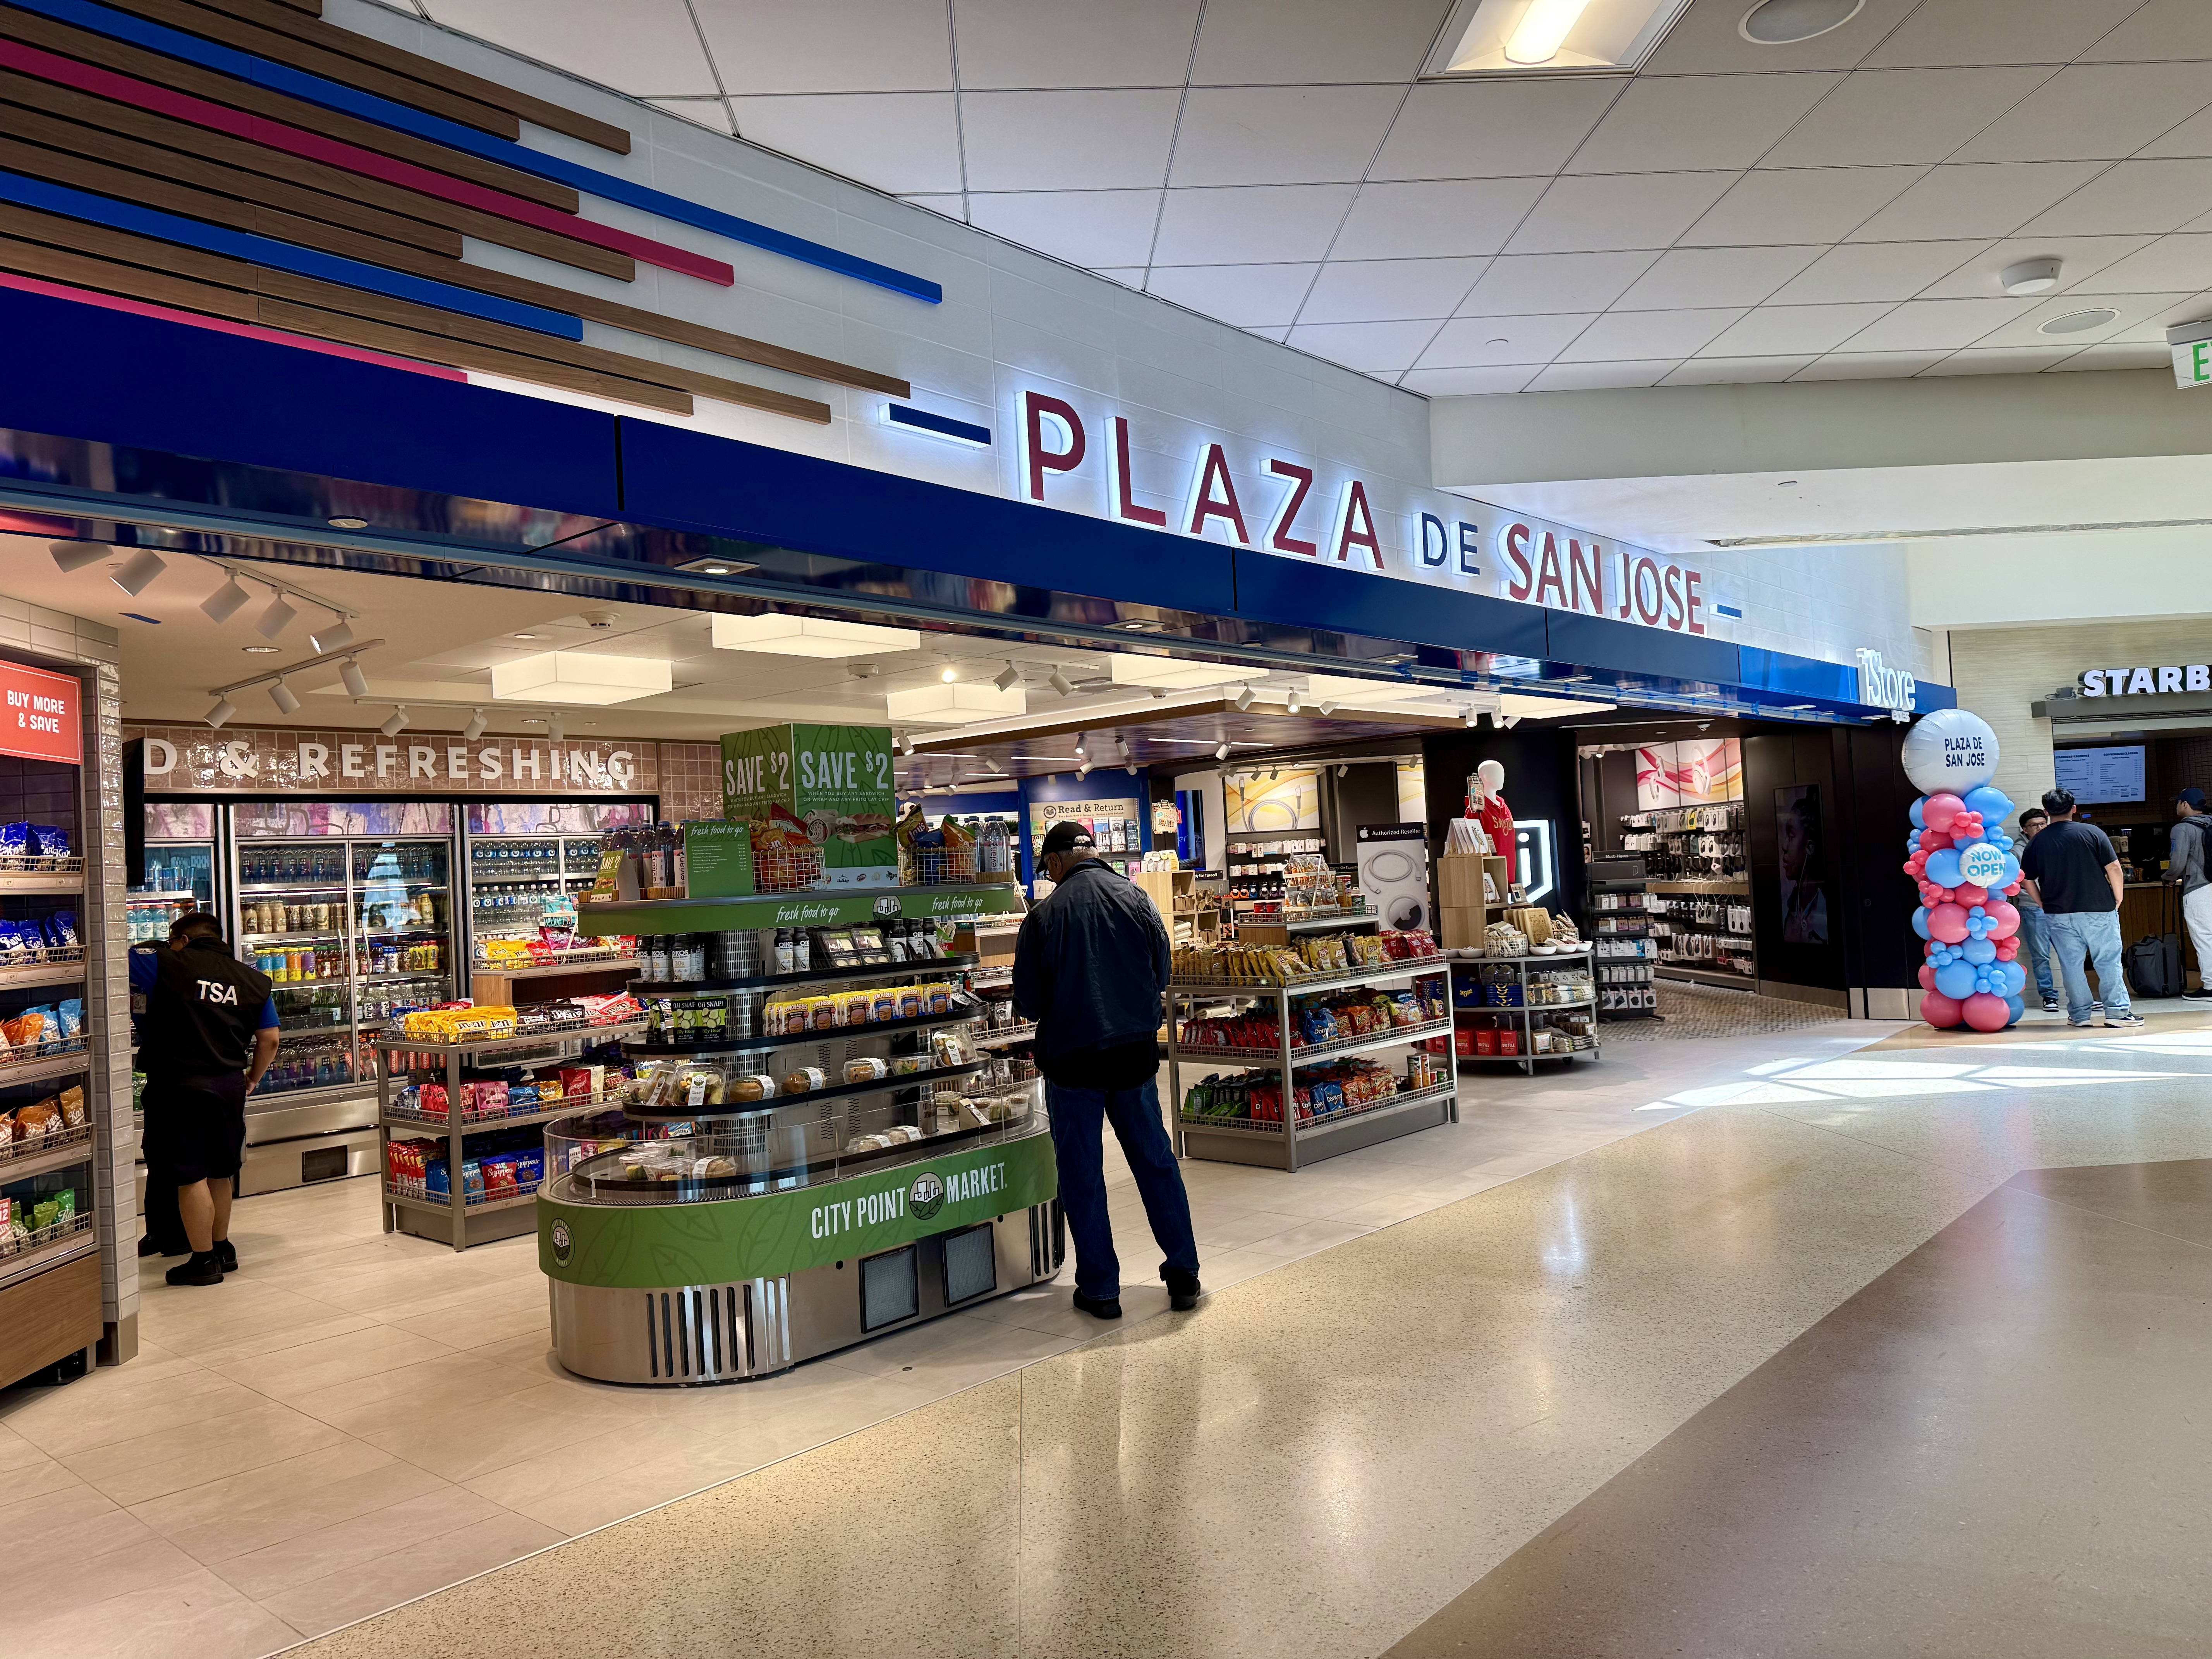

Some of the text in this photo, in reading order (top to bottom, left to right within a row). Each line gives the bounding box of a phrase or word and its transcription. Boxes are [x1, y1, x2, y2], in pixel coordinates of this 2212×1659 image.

[2192, 342, 2212, 381] E
[1025, 390, 1705, 635] PLAZA DE SAN JOSE
[1857, 647, 1916, 711] iStore
[7, 689, 65, 715] BUY MORE
[18, 712, 60, 733] & SAVE
[1944, 737, 1983, 751] PLAZA DE
[220, 740, 259, 779] &
[299, 742, 635, 781] REFRESHING
[801, 750, 889, 789] SAVE $2
[1946, 752, 1985, 768] SAN JOSE
[726, 751, 789, 796] SAVE $2
[1058, 803, 1124, 813] Read & Return
[691, 825, 709, 836] fresh
[710, 824, 727, 836] food
[734, 827, 744, 837] go
[601, 857, 615, 870] SAVE
[1971, 850, 2001, 862] NOW
[1967, 862, 2006, 876] OPEN
[776, 904, 840, 923] fresh food to go
[932, 895, 984, 912] fresh food to go
[197, 979, 237, 1006] TSA
[811, 1200, 851, 1239] CITY
[857, 1187, 906, 1228] POINT
